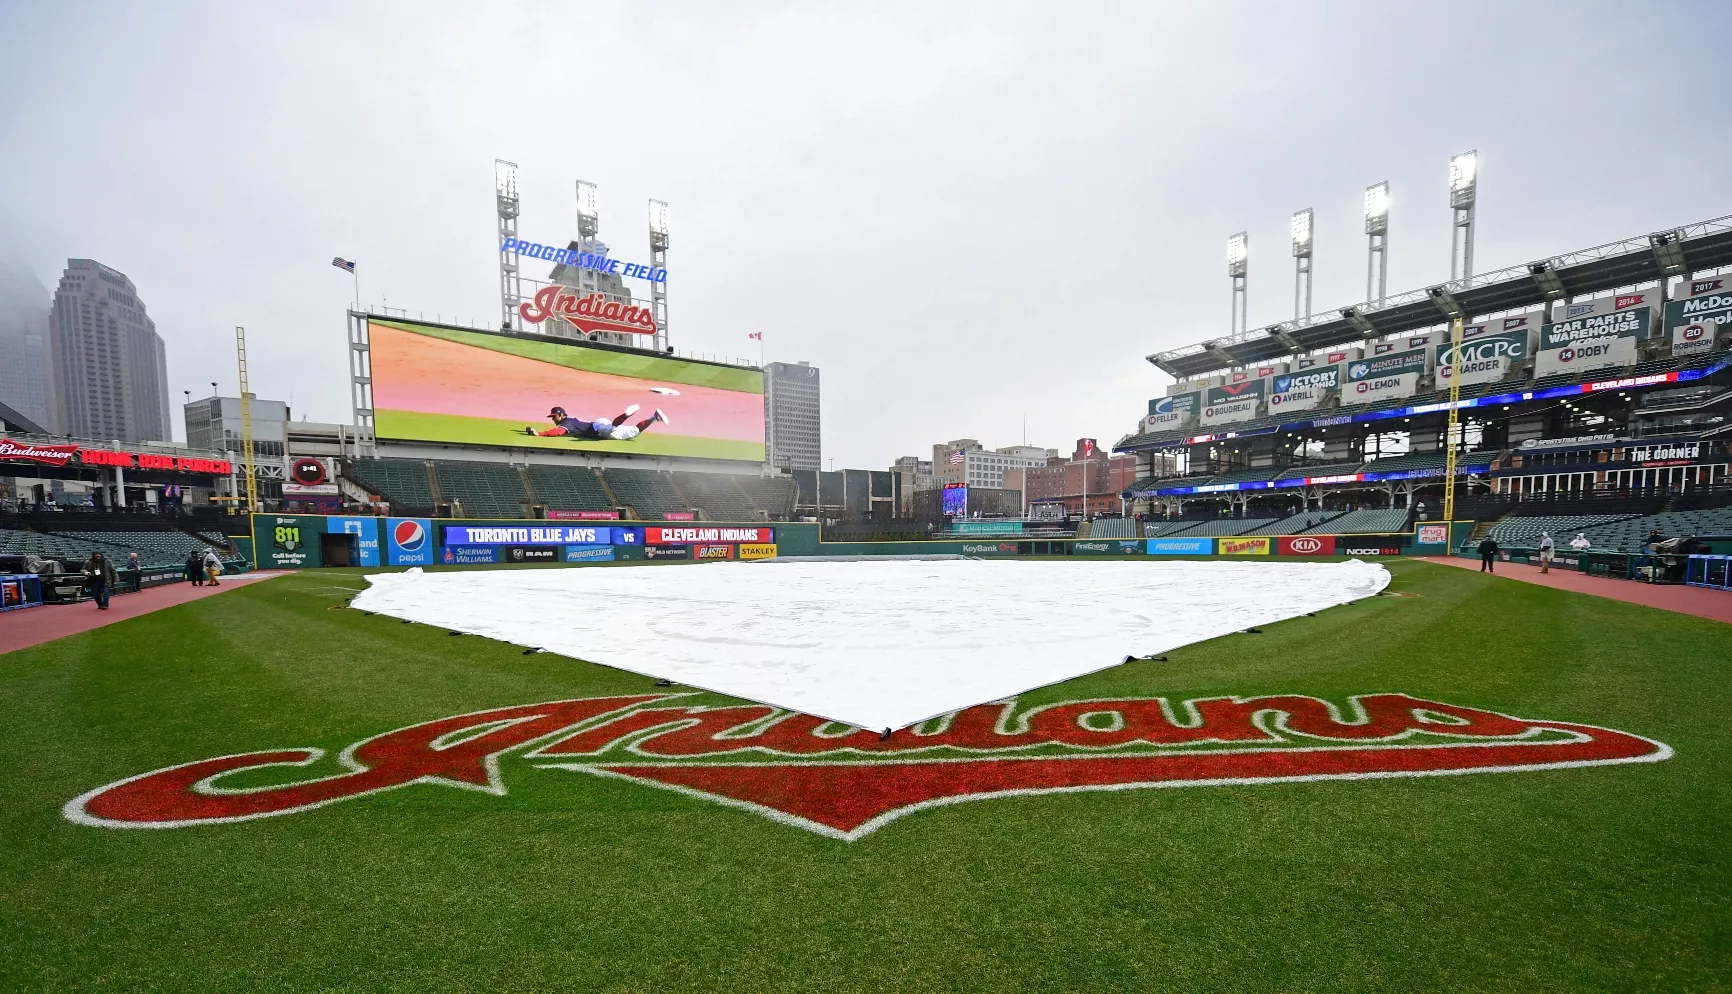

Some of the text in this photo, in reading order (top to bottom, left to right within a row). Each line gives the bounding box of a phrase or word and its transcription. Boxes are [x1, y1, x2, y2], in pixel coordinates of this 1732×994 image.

[502, 238, 667, 283] PROGRESSIVE FIELD
[1695, 282, 1713, 291] 2017
[1618, 297, 1634, 306] 2016
[520, 284, 657, 336] Indians
[1552, 311, 1635, 334] CAR PARTS
[1548, 320, 1639, 343] WAREHOUSE
[1686, 329, 1701, 338] 20
[1673, 338, 1713, 350] ROBINSON
[1561, 344, 1610, 359] 14 DOBY
[1370, 353, 1425, 370] MINUTE MEN
[1369, 378, 1400, 390] LEMON
[1282, 391, 1314, 403] AVERILL
[1215, 403, 1251, 416] BOUDREAU
[1157, 413, 1179, 423] FELLER
[0, 442, 72, 459] Budweiser
[1631, 446, 1699, 461] THE CORNER
[82, 449, 231, 474] HOME RUN PORCH
[275, 527, 299, 543] 811
[466, 528, 595, 543] TORONTO BLUE JAYS
[661, 528, 758, 541] CLEVELAND INDIANS
[1421, 526, 1441, 536] drug
[623, 533, 634, 542] VS
[742, 547, 774, 555] STANLEY
[963, 544, 997, 552] KeyBank
[1156, 543, 1201, 551] PROGRESSIVE
[1295, 540, 1317, 550] KIA
[399, 553, 424, 563] pepsi
[457, 548, 492, 556] SHERWIN
[568, 548, 613, 560] PROGRESSIVE
[700, 547, 728, 558] BLASTER
[63, 692, 1674, 841] Inans
